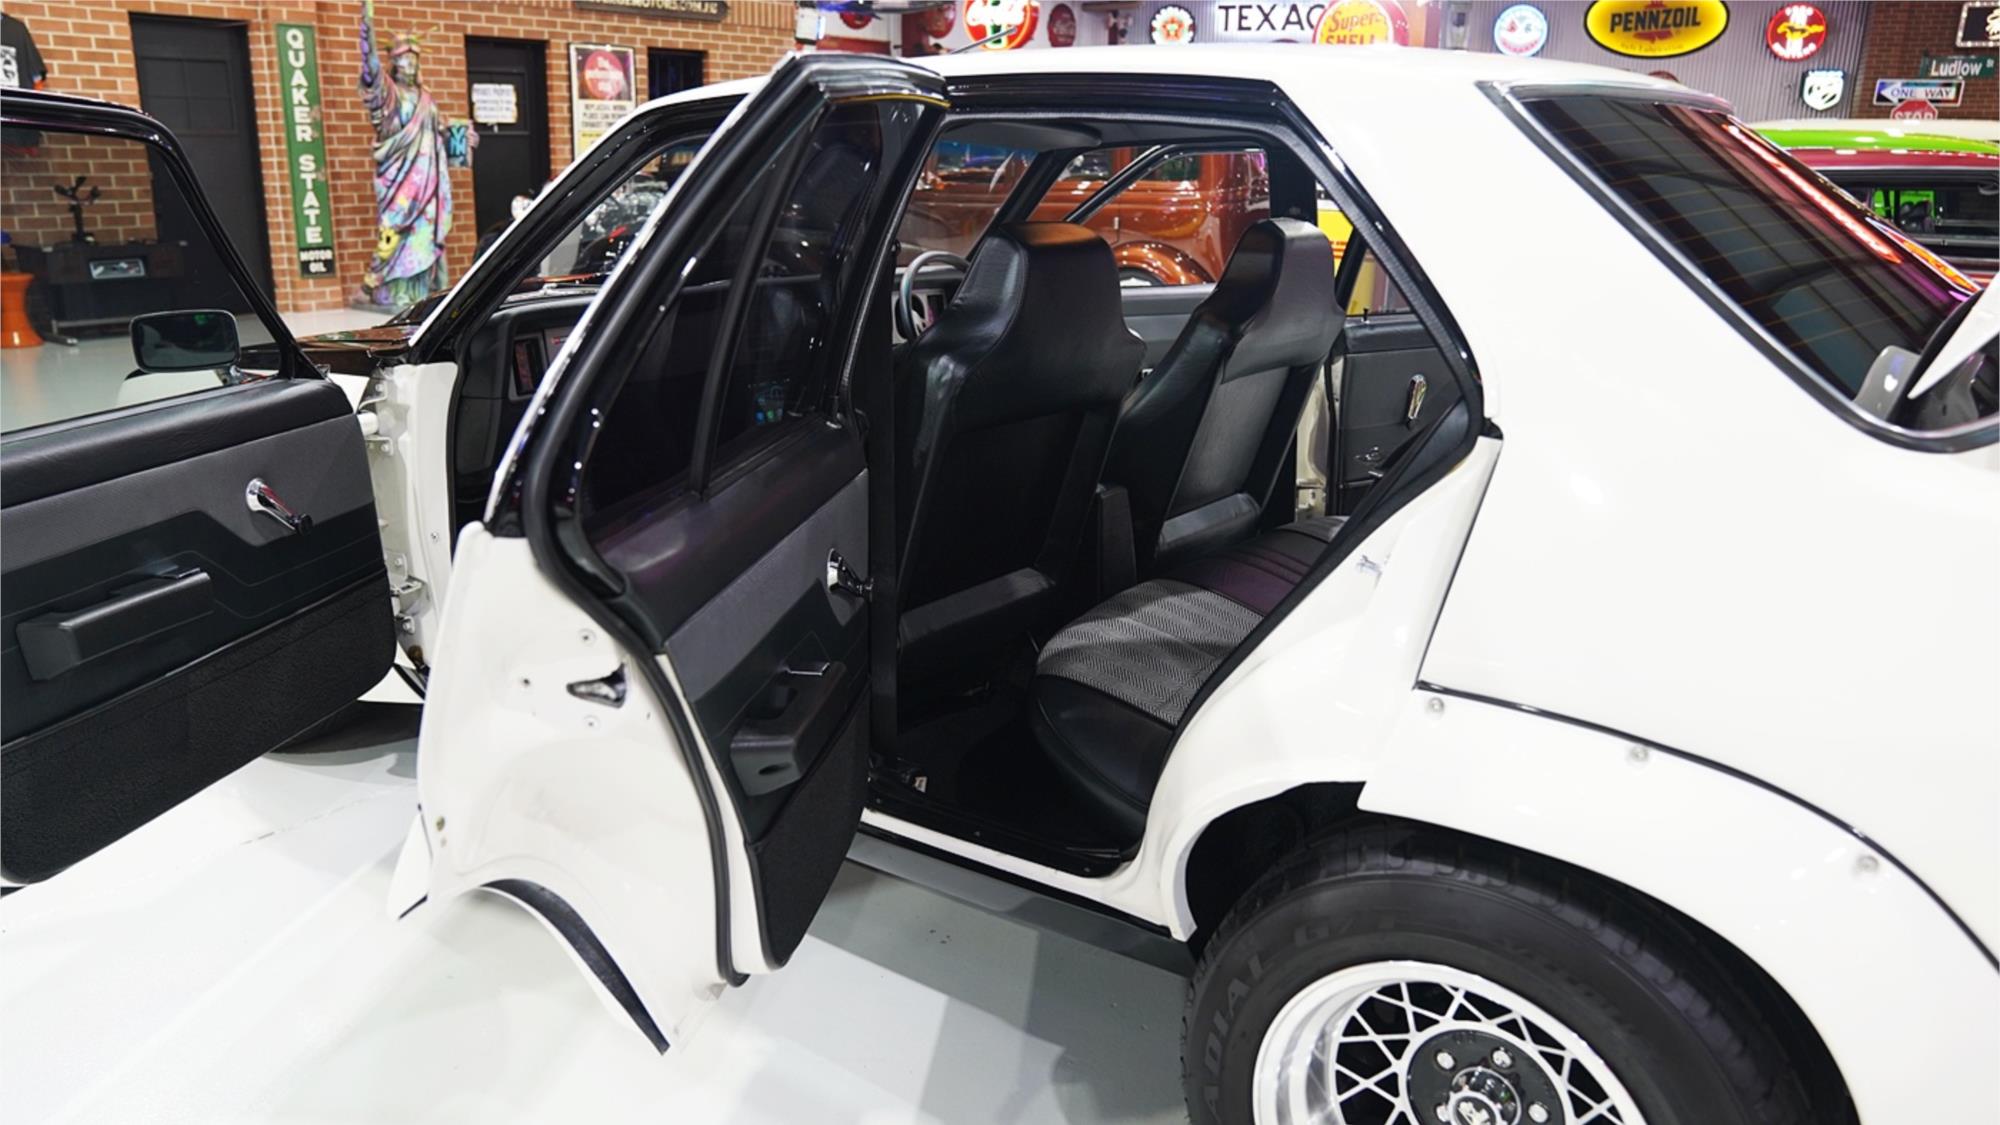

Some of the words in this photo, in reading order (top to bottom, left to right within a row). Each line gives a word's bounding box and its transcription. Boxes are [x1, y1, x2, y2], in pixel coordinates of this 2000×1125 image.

[1218, 4, 1326, 31] TEXAC
[1609, 6, 1701, 33] PENNZOIL
[1930, 59, 1983, 76] Ludlow
[286, 28, 313, 142] QUAKER
[1890, 88, 1917, 98] ONE
[1924, 88, 1952, 98] WAY
[299, 154, 323, 244] STATE
[300, 249, 333, 261] MOTOR
[308, 262, 328, 273] OIL
